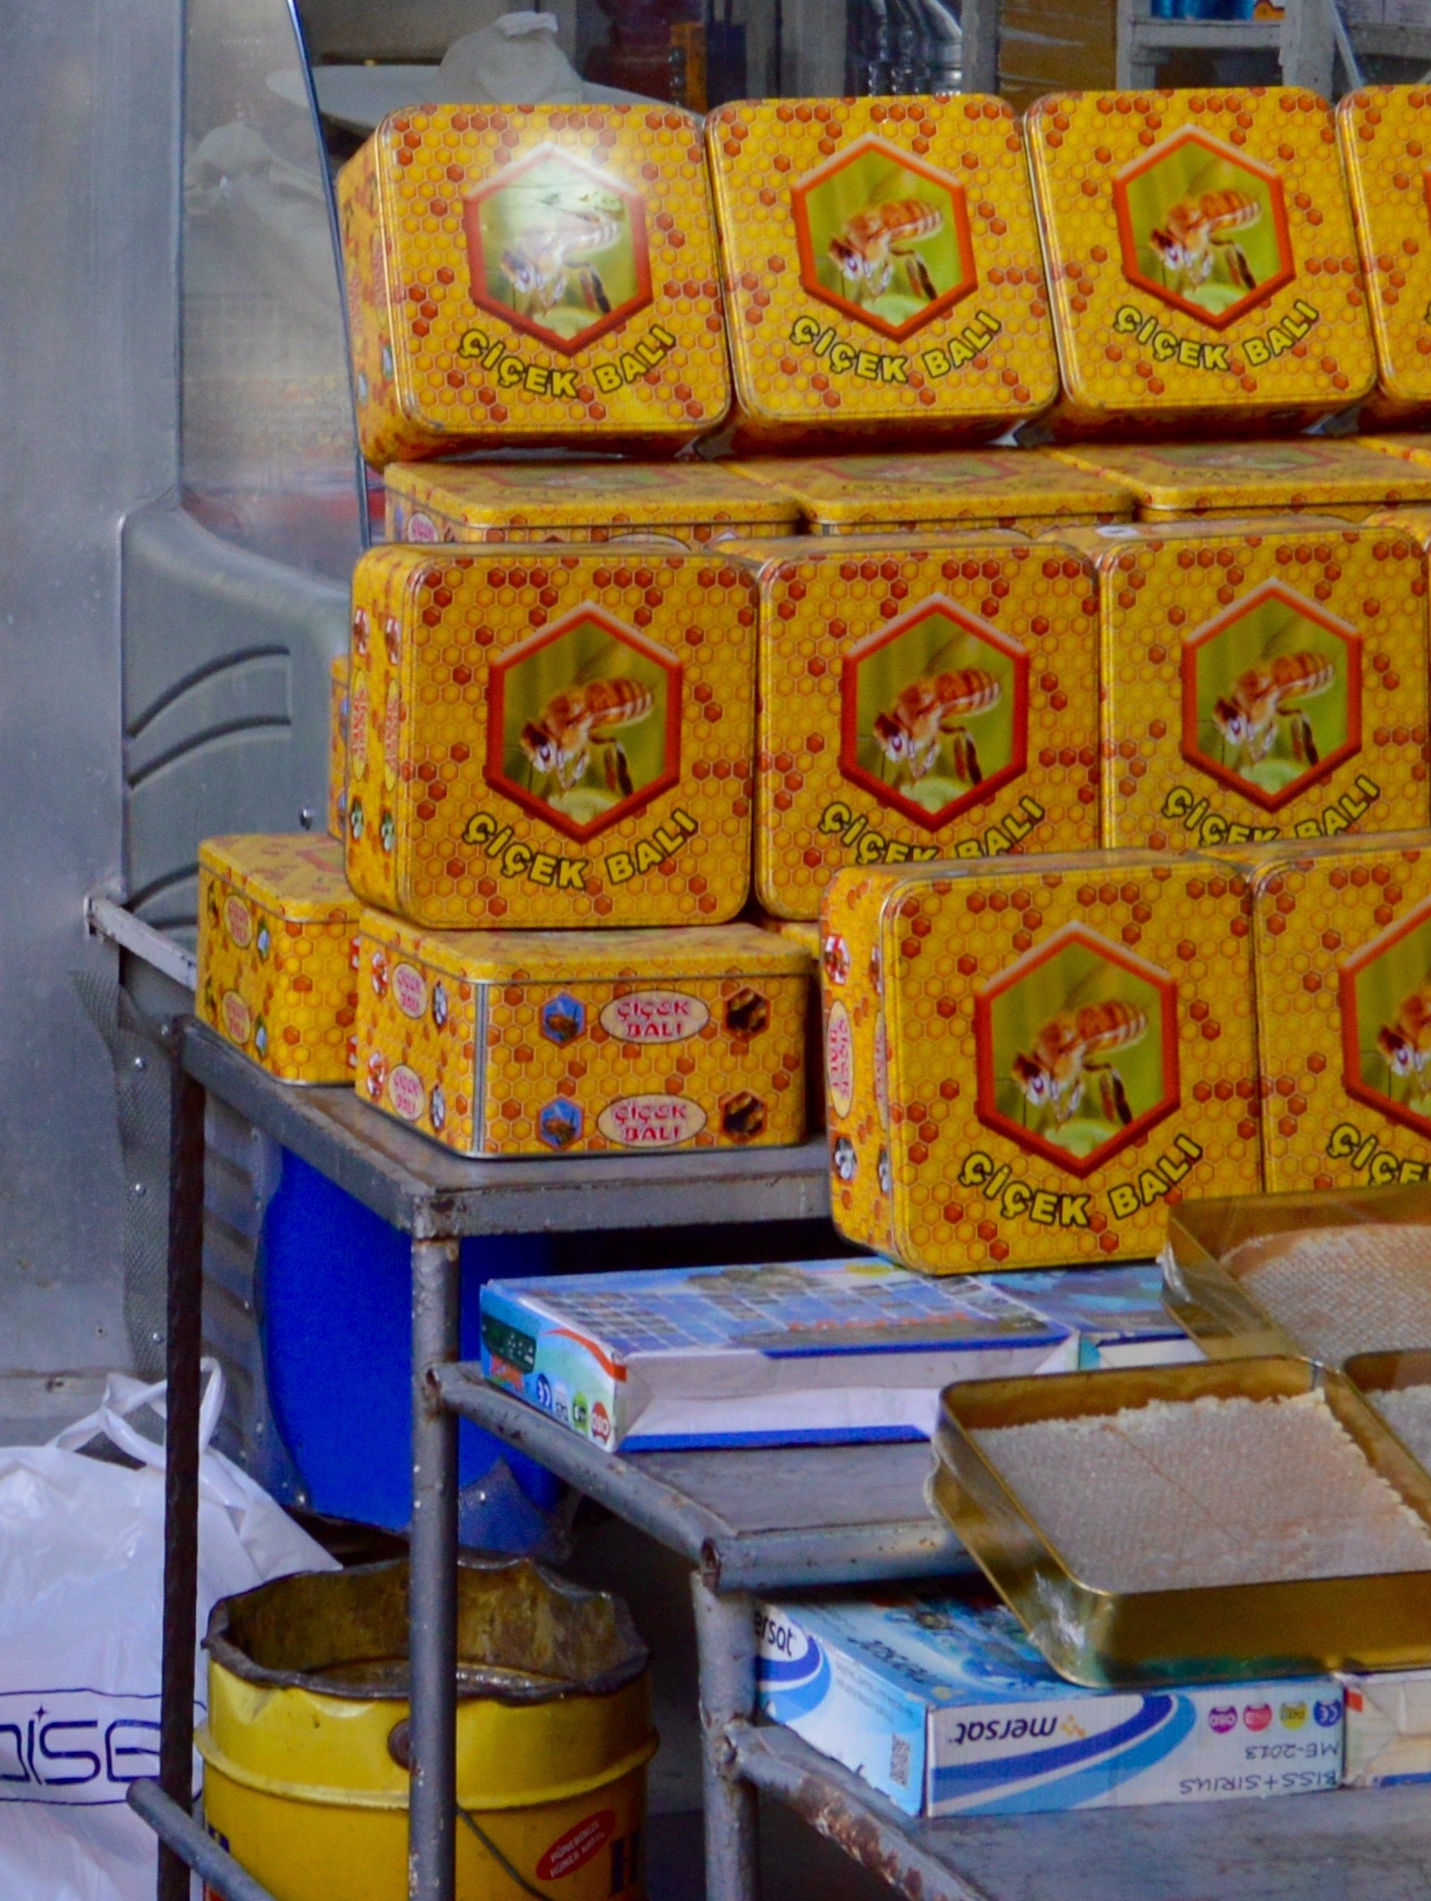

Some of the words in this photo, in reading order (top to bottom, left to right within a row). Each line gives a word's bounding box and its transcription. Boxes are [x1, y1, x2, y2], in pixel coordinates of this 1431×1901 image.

[789, 316, 908, 384] ÇİÇEK
[927, 310, 1002, 380] BALI
[1112, 305, 1230, 371] ÇİÇEK
[1245, 300, 1320, 368] BALI
[458, 329, 579, 398] ÇİÇEK
[594, 323, 677, 394] BALI
[461, 811, 588, 890] ÇİÇEK
[607, 808, 699, 884] BALI
[617, 999, 689, 1021] ÇİÇEK
[627, 1022, 683, 1038] BALI
[614, 1101, 686, 1124] ÇİÇEK
[624, 1125, 680, 1142] BALI
[958, 1150, 1091, 1228] ÇİÇEK
[1106, 1133, 1205, 1220] BALI
[754, 1611, 797, 1656] ersat
[956, 1716, 1059, 1746] mersat
[1244, 1742, 1338, 1760] ME-2013
[1179, 1769, 1338, 1794] BISS+SIRIUS
